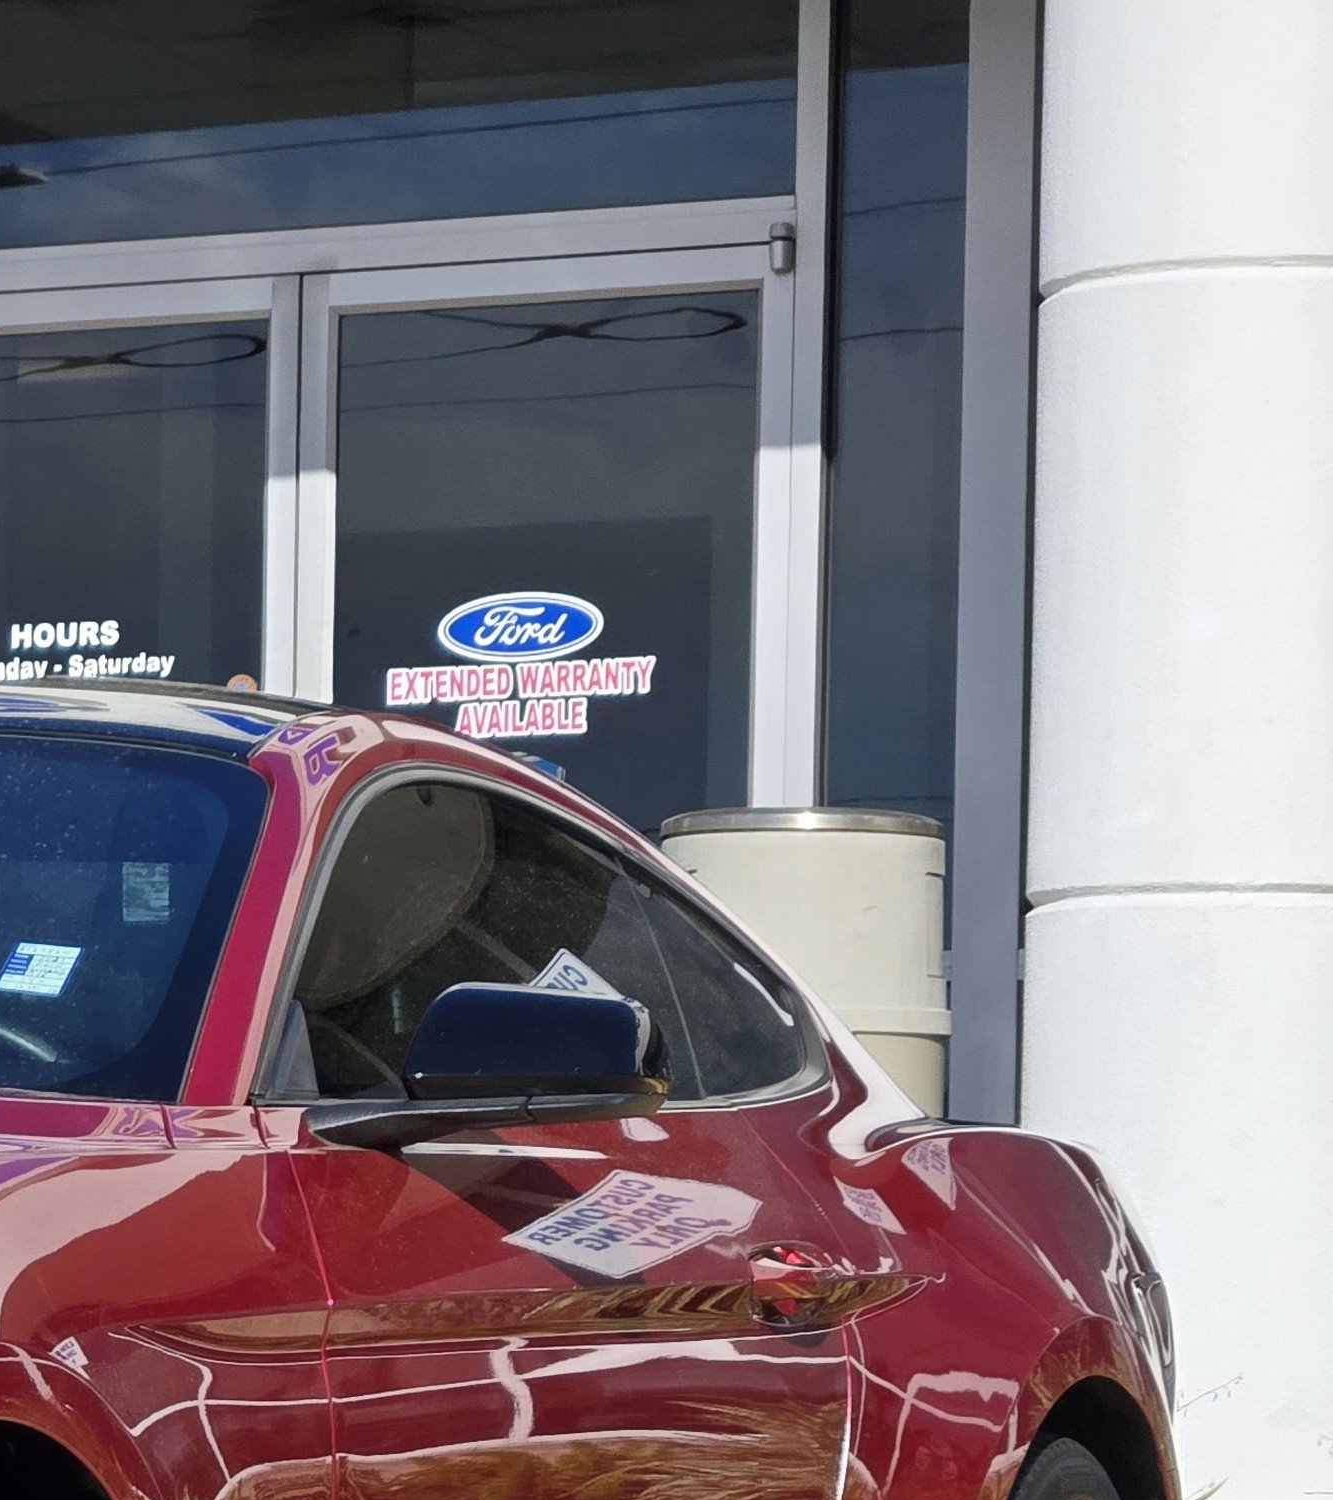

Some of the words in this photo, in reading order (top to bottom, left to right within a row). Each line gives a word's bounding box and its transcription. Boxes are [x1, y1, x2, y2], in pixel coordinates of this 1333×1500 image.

[11, 620, 120, 650] HOURS
[474, 606, 568, 646] Ford
[68, 652, 175, 679] Saturday
[389, 666, 513, 702] EXTENDED
[517, 658, 653, 696] WARRANTY
[459, 700, 587, 736] AVAILABLE
